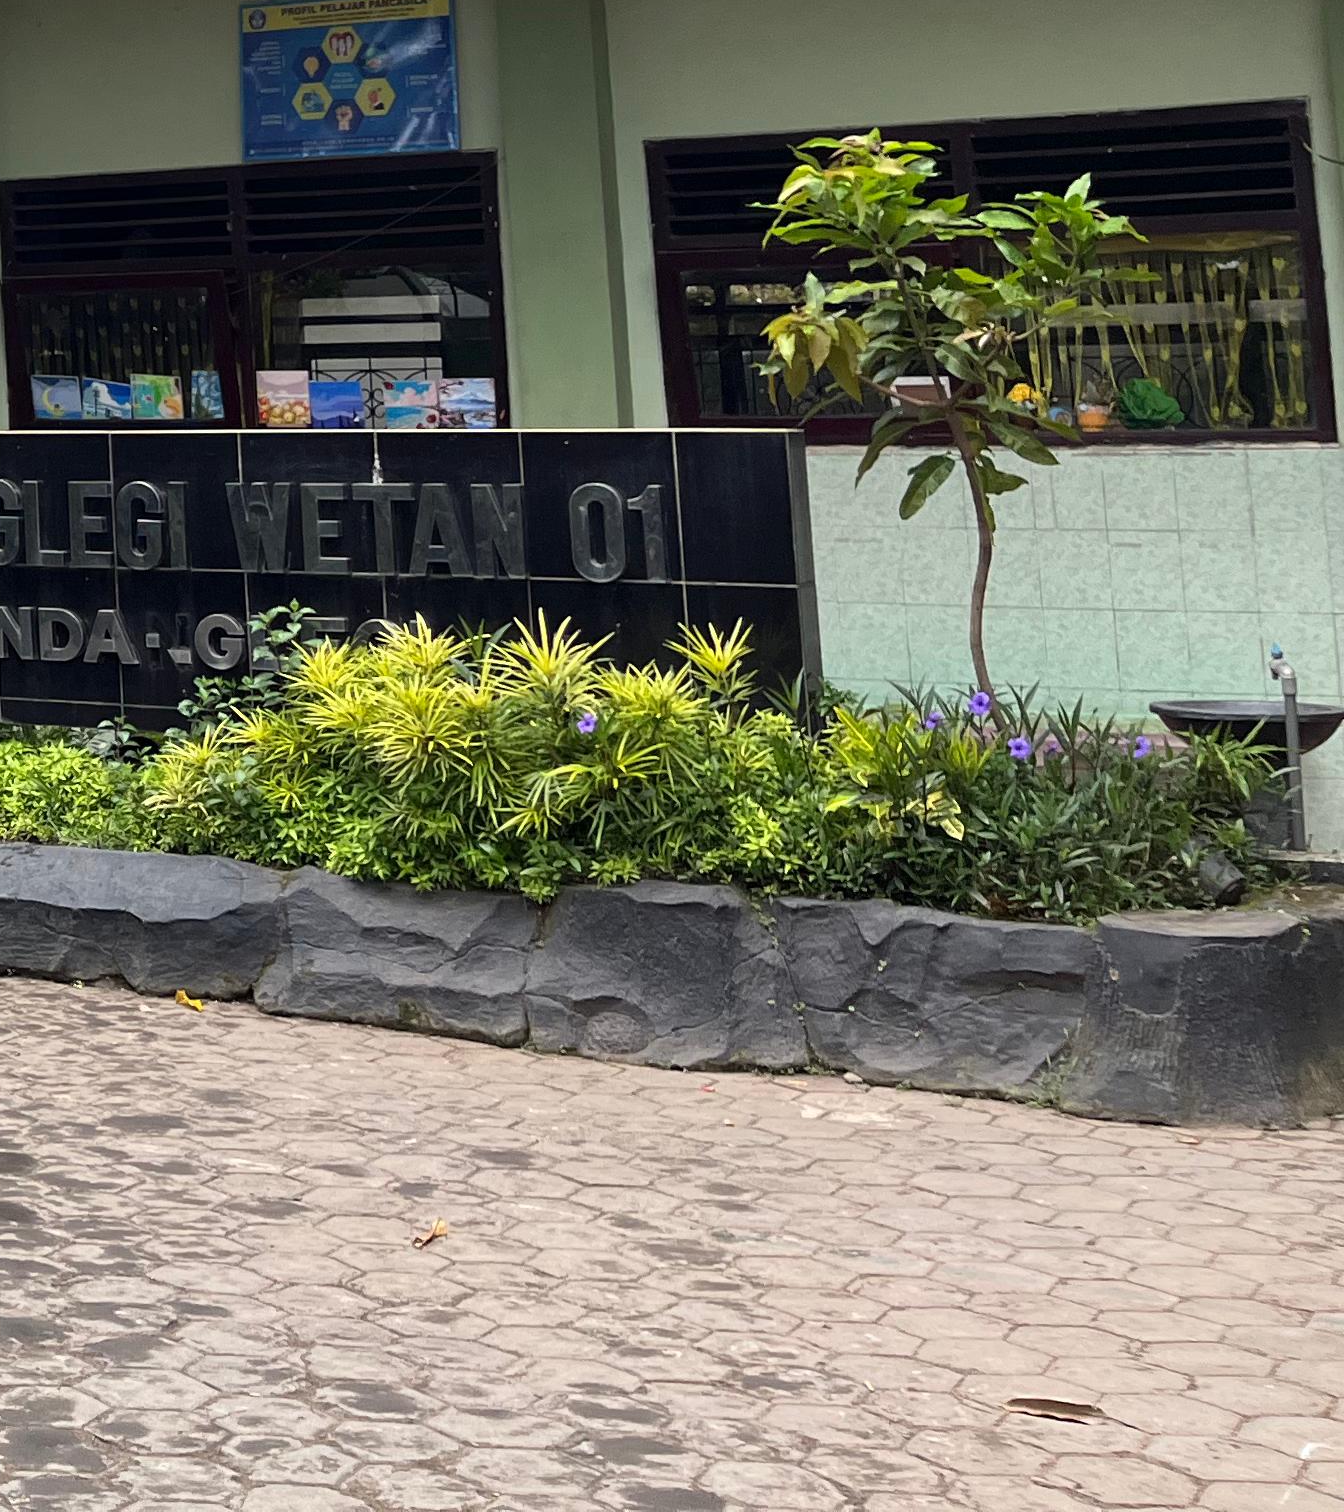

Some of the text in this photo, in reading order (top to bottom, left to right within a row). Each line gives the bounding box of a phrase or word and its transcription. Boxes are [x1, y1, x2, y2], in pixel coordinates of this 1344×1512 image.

[281, 6, 317, 16] PROFIL
[320, 1, 366, 12] PELAJAR
[225, 482, 529, 580] WETAN
[568, 482, 670, 584] 01
